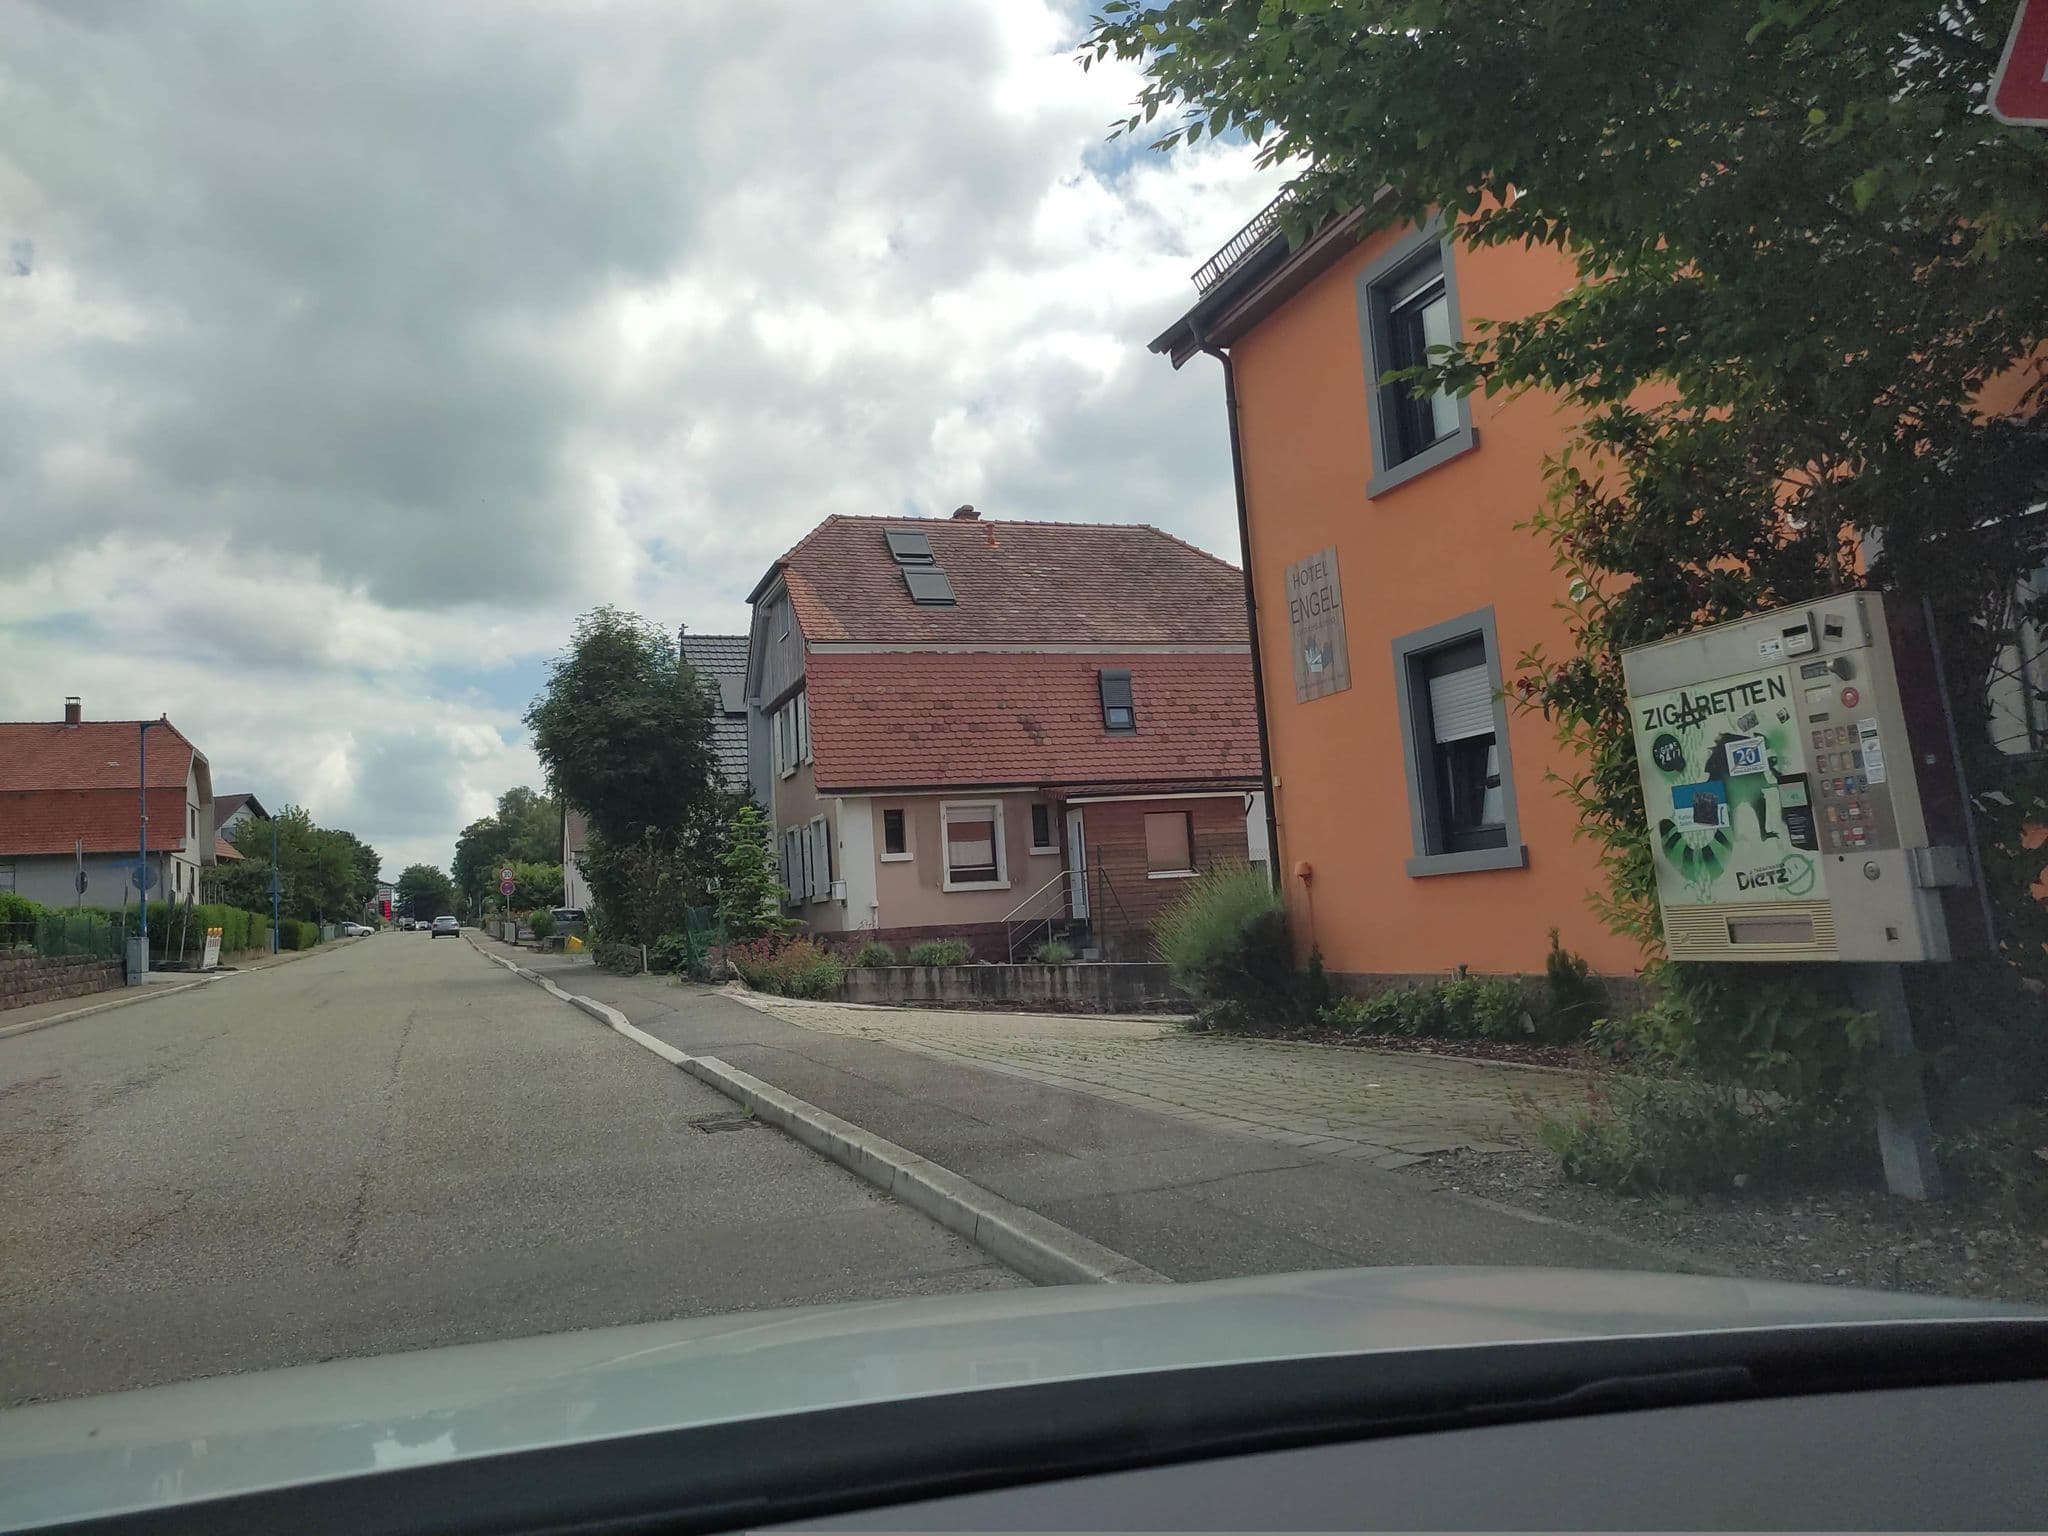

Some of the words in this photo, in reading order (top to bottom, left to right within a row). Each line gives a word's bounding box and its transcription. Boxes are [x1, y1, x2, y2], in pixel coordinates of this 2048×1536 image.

[1293, 560, 1328, 590] HOTEL
[1291, 585, 1339, 625] ENGEL
[1642, 675, 1786, 731] ZIGARETTEN
[1736, 748, 1756, 766] 20
